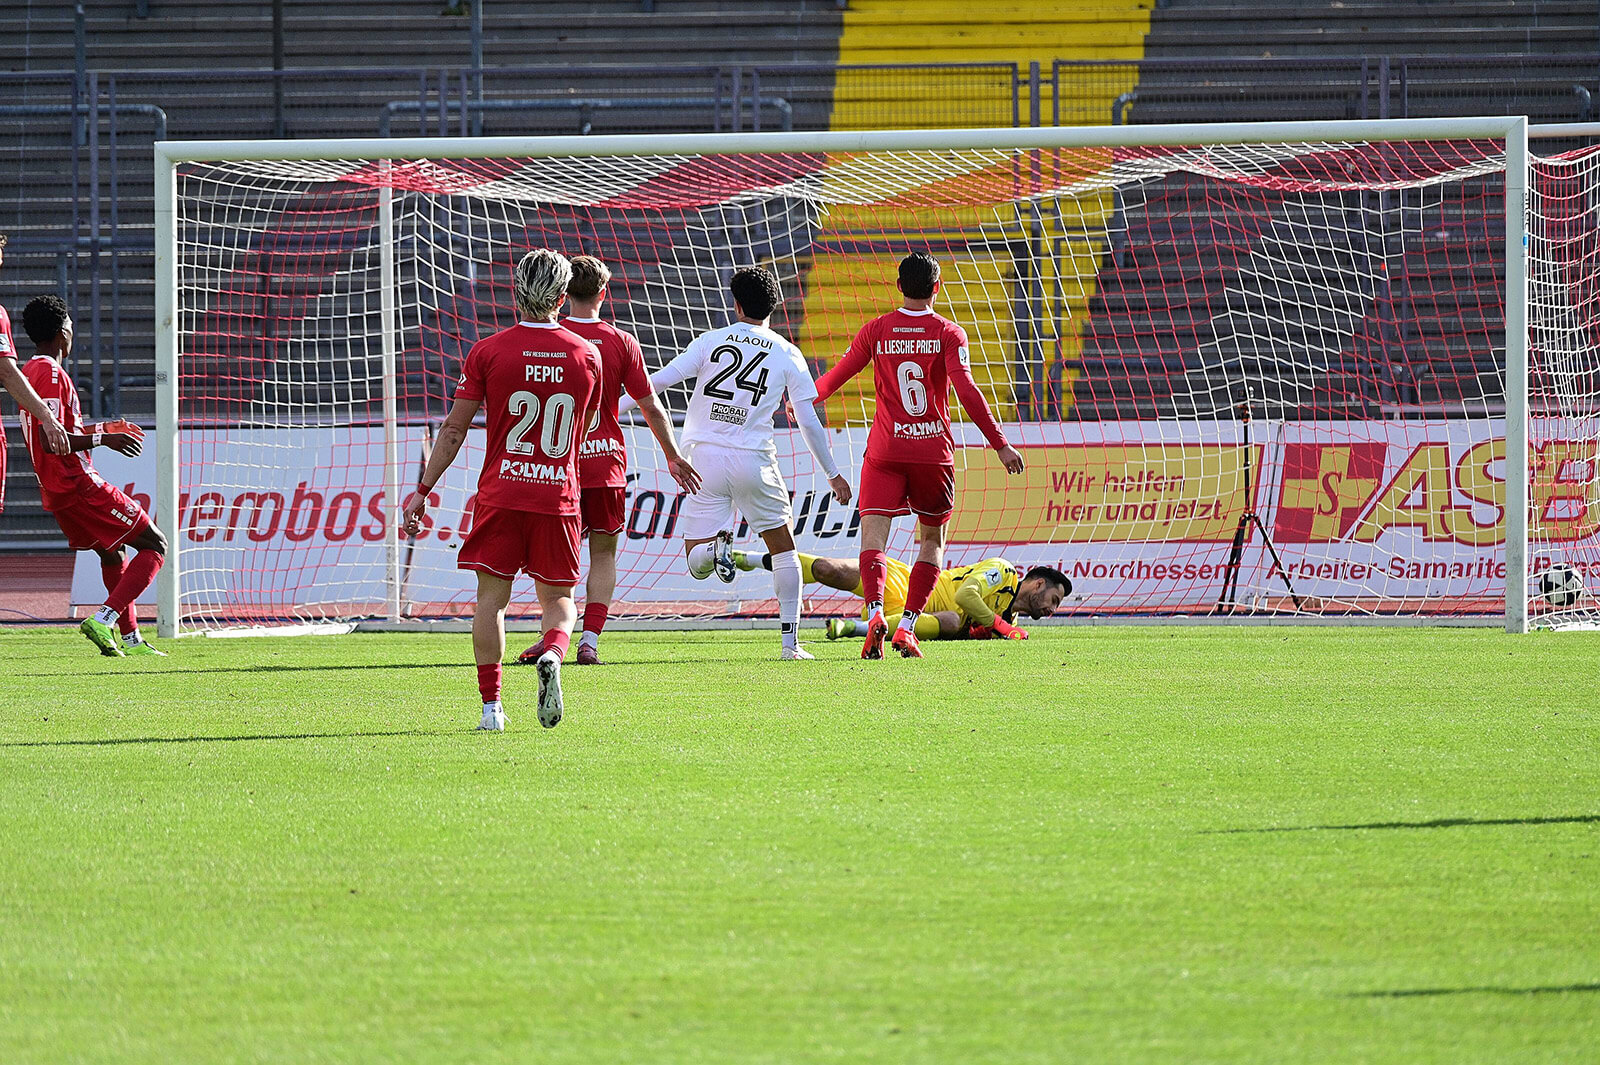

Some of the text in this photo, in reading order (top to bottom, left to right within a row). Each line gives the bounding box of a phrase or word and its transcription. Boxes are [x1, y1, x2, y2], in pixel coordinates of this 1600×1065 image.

[725, 333, 773, 350] ALAOUI
[884, 339, 915, 355] LIESCHE
[916, 338, 941, 354] PRIETO
[525, 364, 564, 383] PEPIC
[703, 344, 769, 407] 24
[897, 361, 928, 417] 6
[505, 390, 575, 459] 20
[893, 419, 945, 436] POLYMA
[500, 458, 567, 481] POLYMA
[1051, 470, 1186, 493] Wir helfen
[1046, 499, 1227, 526] hier und jetzt.
